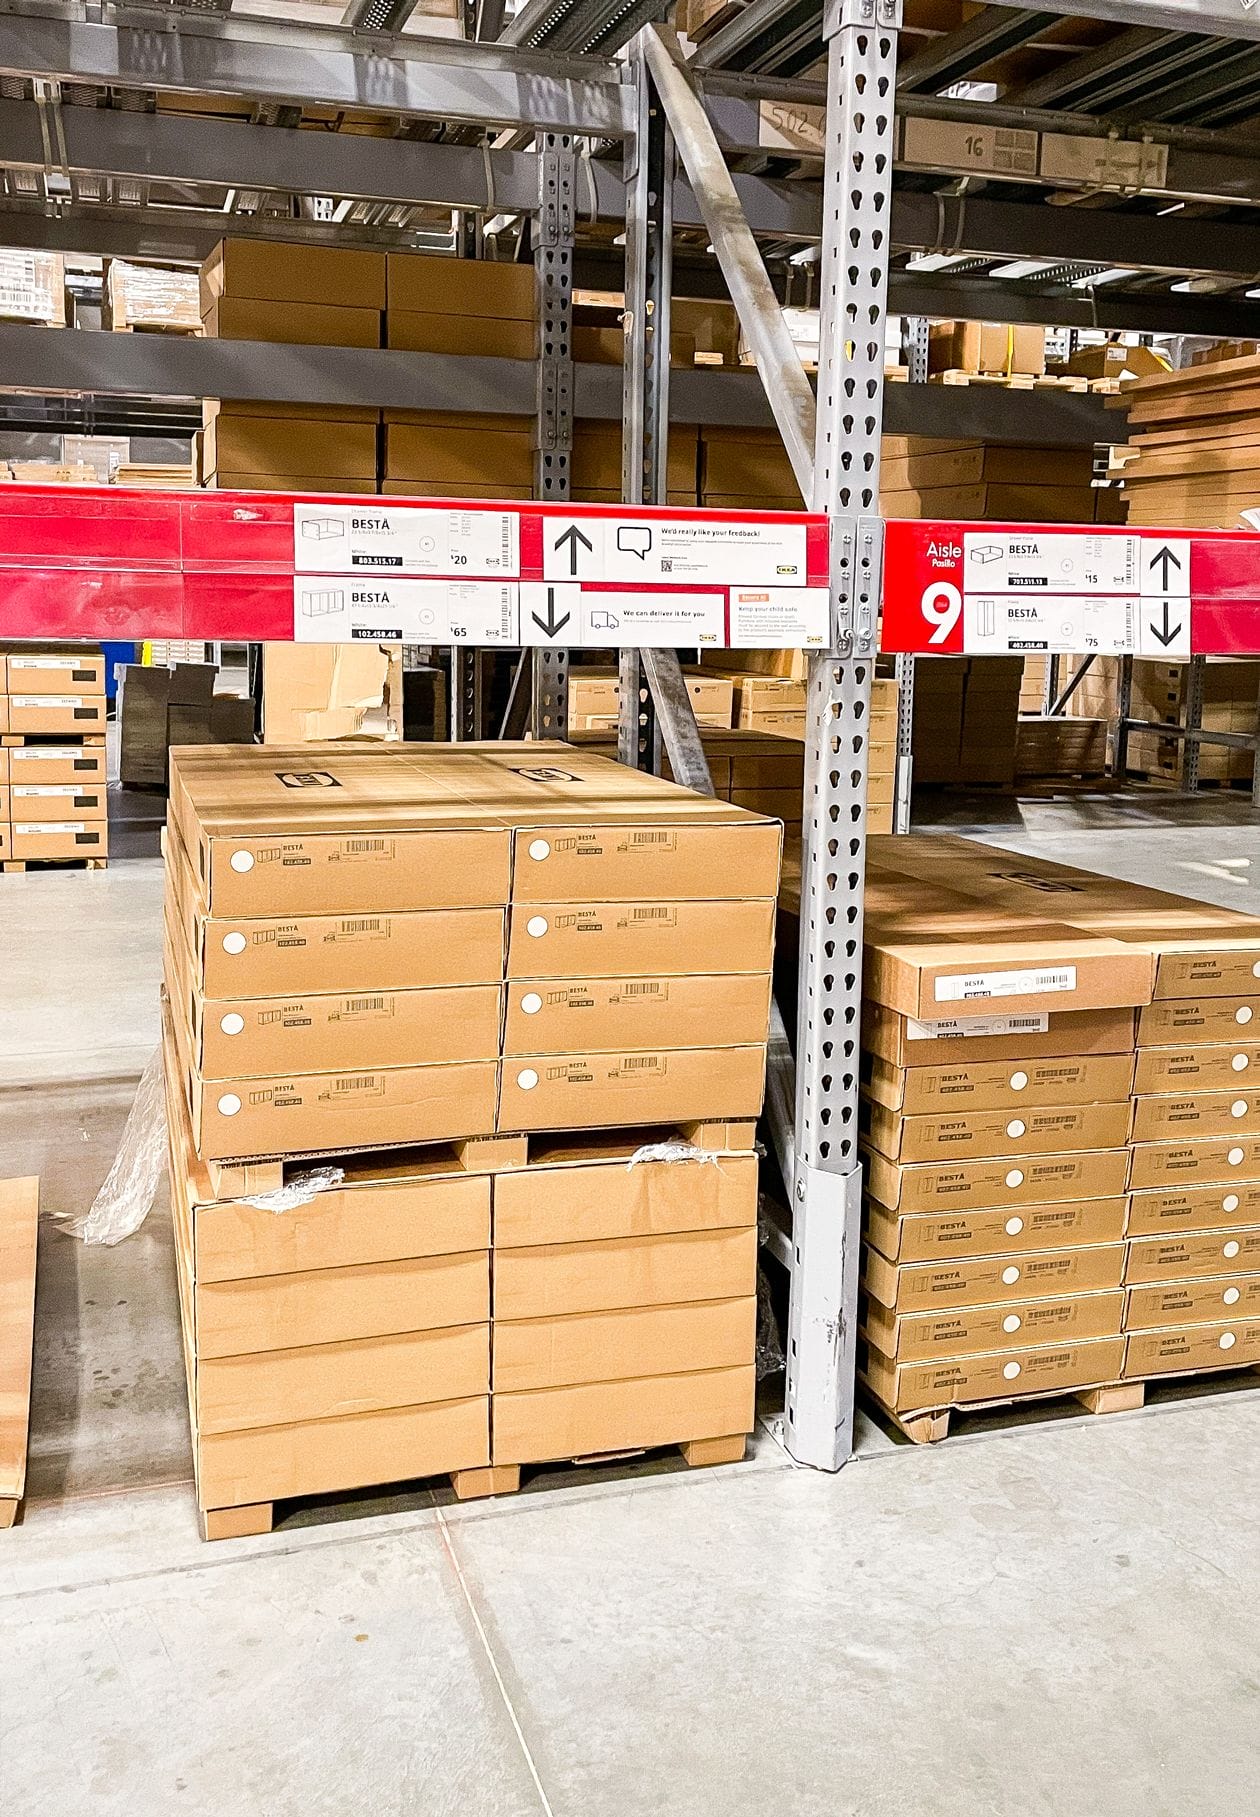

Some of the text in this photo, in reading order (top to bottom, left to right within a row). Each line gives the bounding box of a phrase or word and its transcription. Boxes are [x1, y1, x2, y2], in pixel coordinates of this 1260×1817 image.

[965, 136, 983, 156] 16
[352, 517, 390, 530] BESTÅ
[678, 528, 697, 537] really
[728, 529, 760, 537] feedback!
[926, 541, 962, 558] Aisle
[1009, 544, 1039, 554] BESTÅ
[451, 554, 467, 565] $20
[932, 559, 955, 568] Pasillo
[1086, 574, 1098, 583] $15
[352, 592, 390, 603] BESTÅ
[921, 581, 962, 644] 9
[1008, 607, 1038, 618] BESTÅ
[450, 627, 467, 637] $65
[1086, 638, 1098, 647] $75
